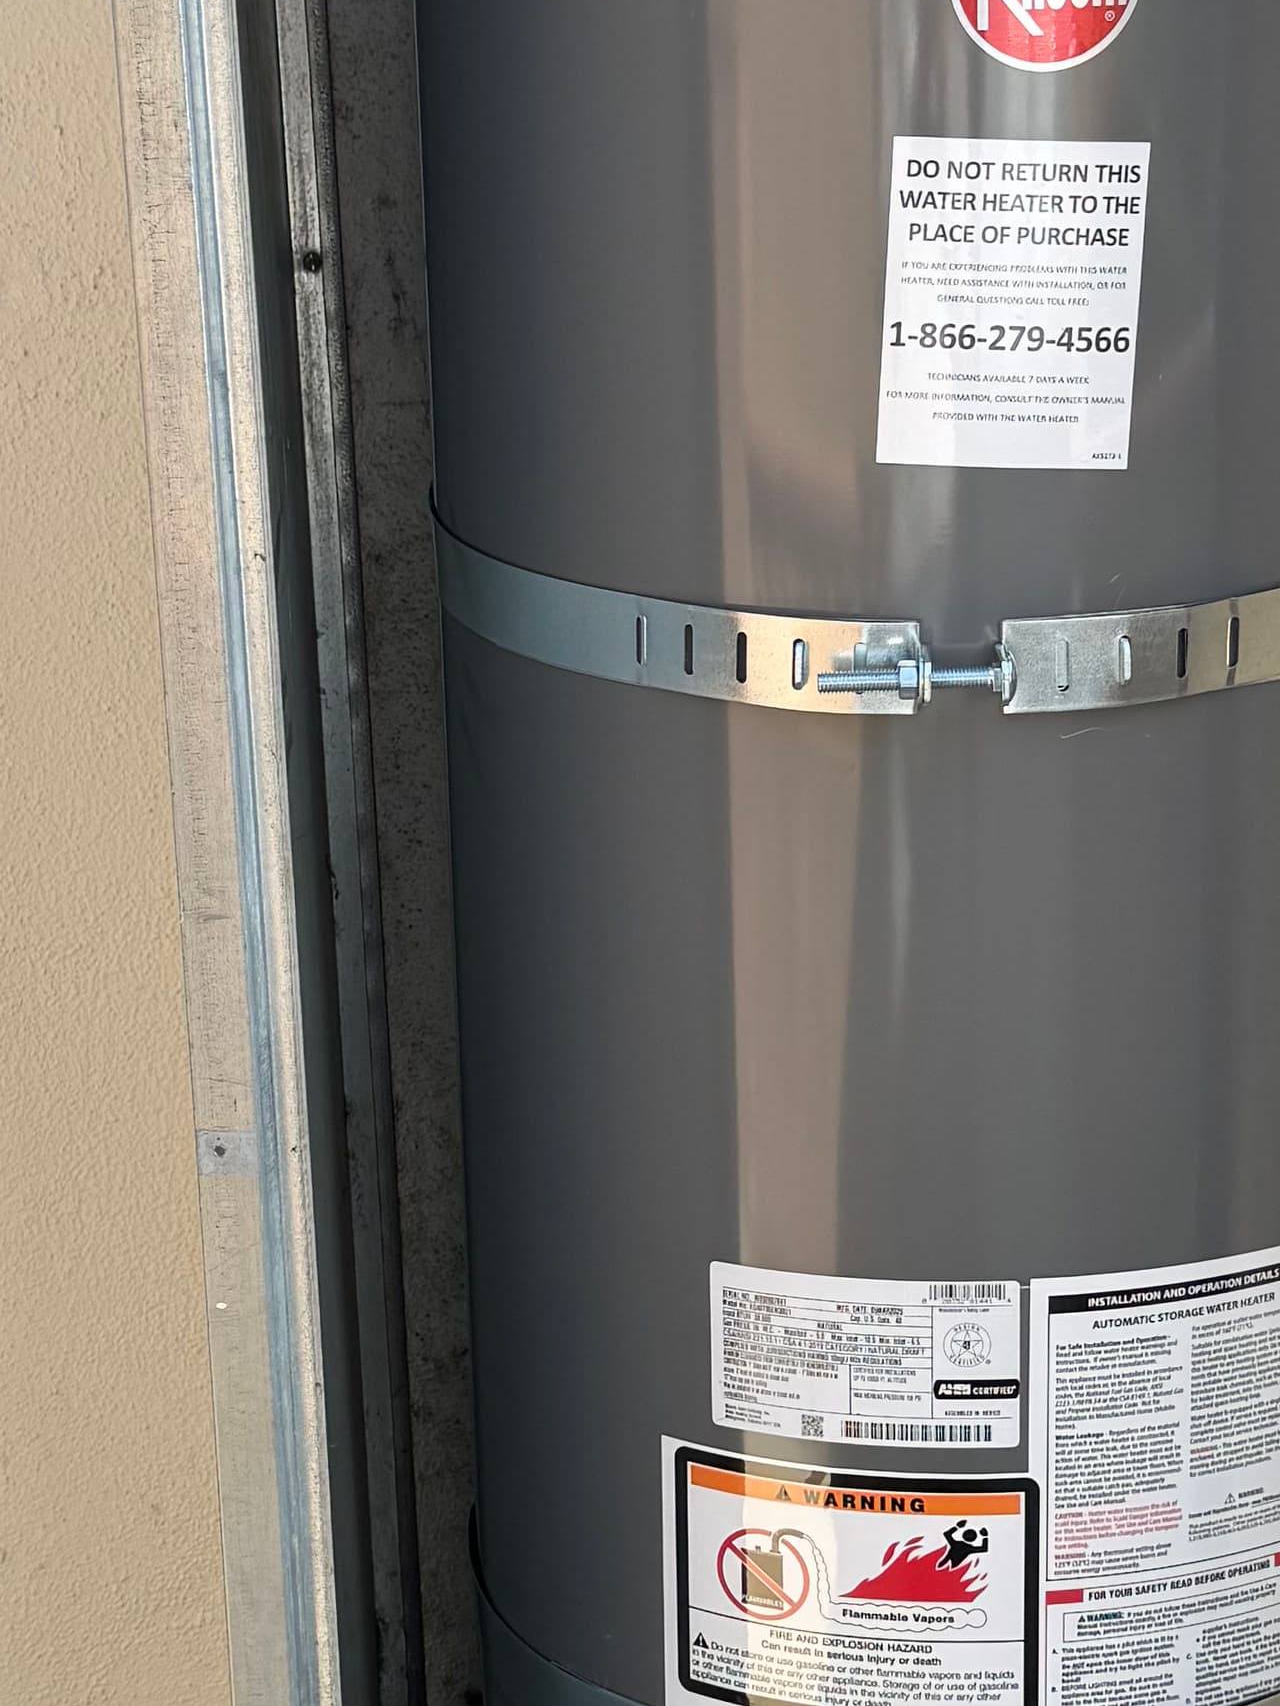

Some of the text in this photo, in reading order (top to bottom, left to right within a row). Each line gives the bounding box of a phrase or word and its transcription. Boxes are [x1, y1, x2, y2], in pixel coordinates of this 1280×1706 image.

[907, 160, 1141, 183] DO NOT RETURN THIS
[900, 190, 1140, 214] WATER HEATER TO THE
[909, 223, 1130, 246] PLACE OF PURCHASE
[901, 261, 908, 269] IF
[910, 261, 929, 270] YOU
[931, 263, 947, 271] ARE
[1056, 266, 1078, 274] WITH
[1080, 266, 1097, 274] THIS
[901, 276, 935, 285] HEATER,
[937, 278, 959, 286] NEED
[961, 279, 1009, 288] ASSISTANCE
[1036, 281, 1095, 290] INSTALLATION,
[937, 294, 975, 304] GENERAL
[976, 296, 1024, 305] QUESTIONS
[1025, 297, 1045, 305] CALL
[1047, 298, 1066, 306] TOLL
[889, 321, 1131, 353] 1-866-279-4566
[928, 372, 1090, 384] TECHNICIANS AVAILABLE 7 DAYS A WEEK
[886, 390, 903, 399] FOR
[905, 391, 929, 400] MORE
[931, 393, 993, 404] INFORMATION,
[995, 395, 1033, 404] CONSULT
[932, 412, 974, 422] PROVIDED
[976, 414, 998, 422] WITH
[1017, 415, 1046, 423] WATER
[1088, 1268, 1280, 1307] INSTALLATION AND OPERATION DETAILS
[1092, 1292, 1275, 1330] AUTOMATIC STORAGE WATER HEATER
[803, 1488, 926, 1513] WARNING
[1088, 1559, 1271, 1601] FOR YOUR SAFETY READ BEFORE OPERATING
[842, 1609, 955, 1624] Flammable Vapors
[761, 1639, 781, 1651] Can
[784, 1644, 812, 1655] result
[827, 1650, 864, 1662] serious
[899, 1657, 910, 1665] or
[913, 1656, 942, 1666] death
[769, 1629, 933, 1654] FIRE AND EXPLOSION HAZARD
[701, 1649, 715, 1660] the
[716, 1653, 744, 1669] vicinity
[746, 1659, 756, 1669] of
[757, 1663, 773, 1674] this
[775, 1668, 785, 1676] or
[787, 1670, 805, 1680] any
[806, 1671, 829, 1682] other
[882, 1679, 920, 1692] Storage
[923, 1681, 932, 1691] of
[934, 1683, 944, 1691] or
[947, 1682, 964, 1691] use
[967, 1681, 977, 1691] of
[979, 1681, 1019, 1693] gasoline
[711, 1641, 723, 1652] Do
[725, 1645, 740, 1656] not
[765, 1654, 775, 1662] or
[777, 1657, 794, 1666] use
[796, 1658, 835, 1673] gasoline
[837, 1664, 847, 1673] or
[849, 1666, 873, 1676] other
[876, 1668, 926, 1679] flammable
[928, 1671, 961, 1681] vapors
[963, 1670, 982, 1680] and
[984, 1670, 1015, 1682] liquids
